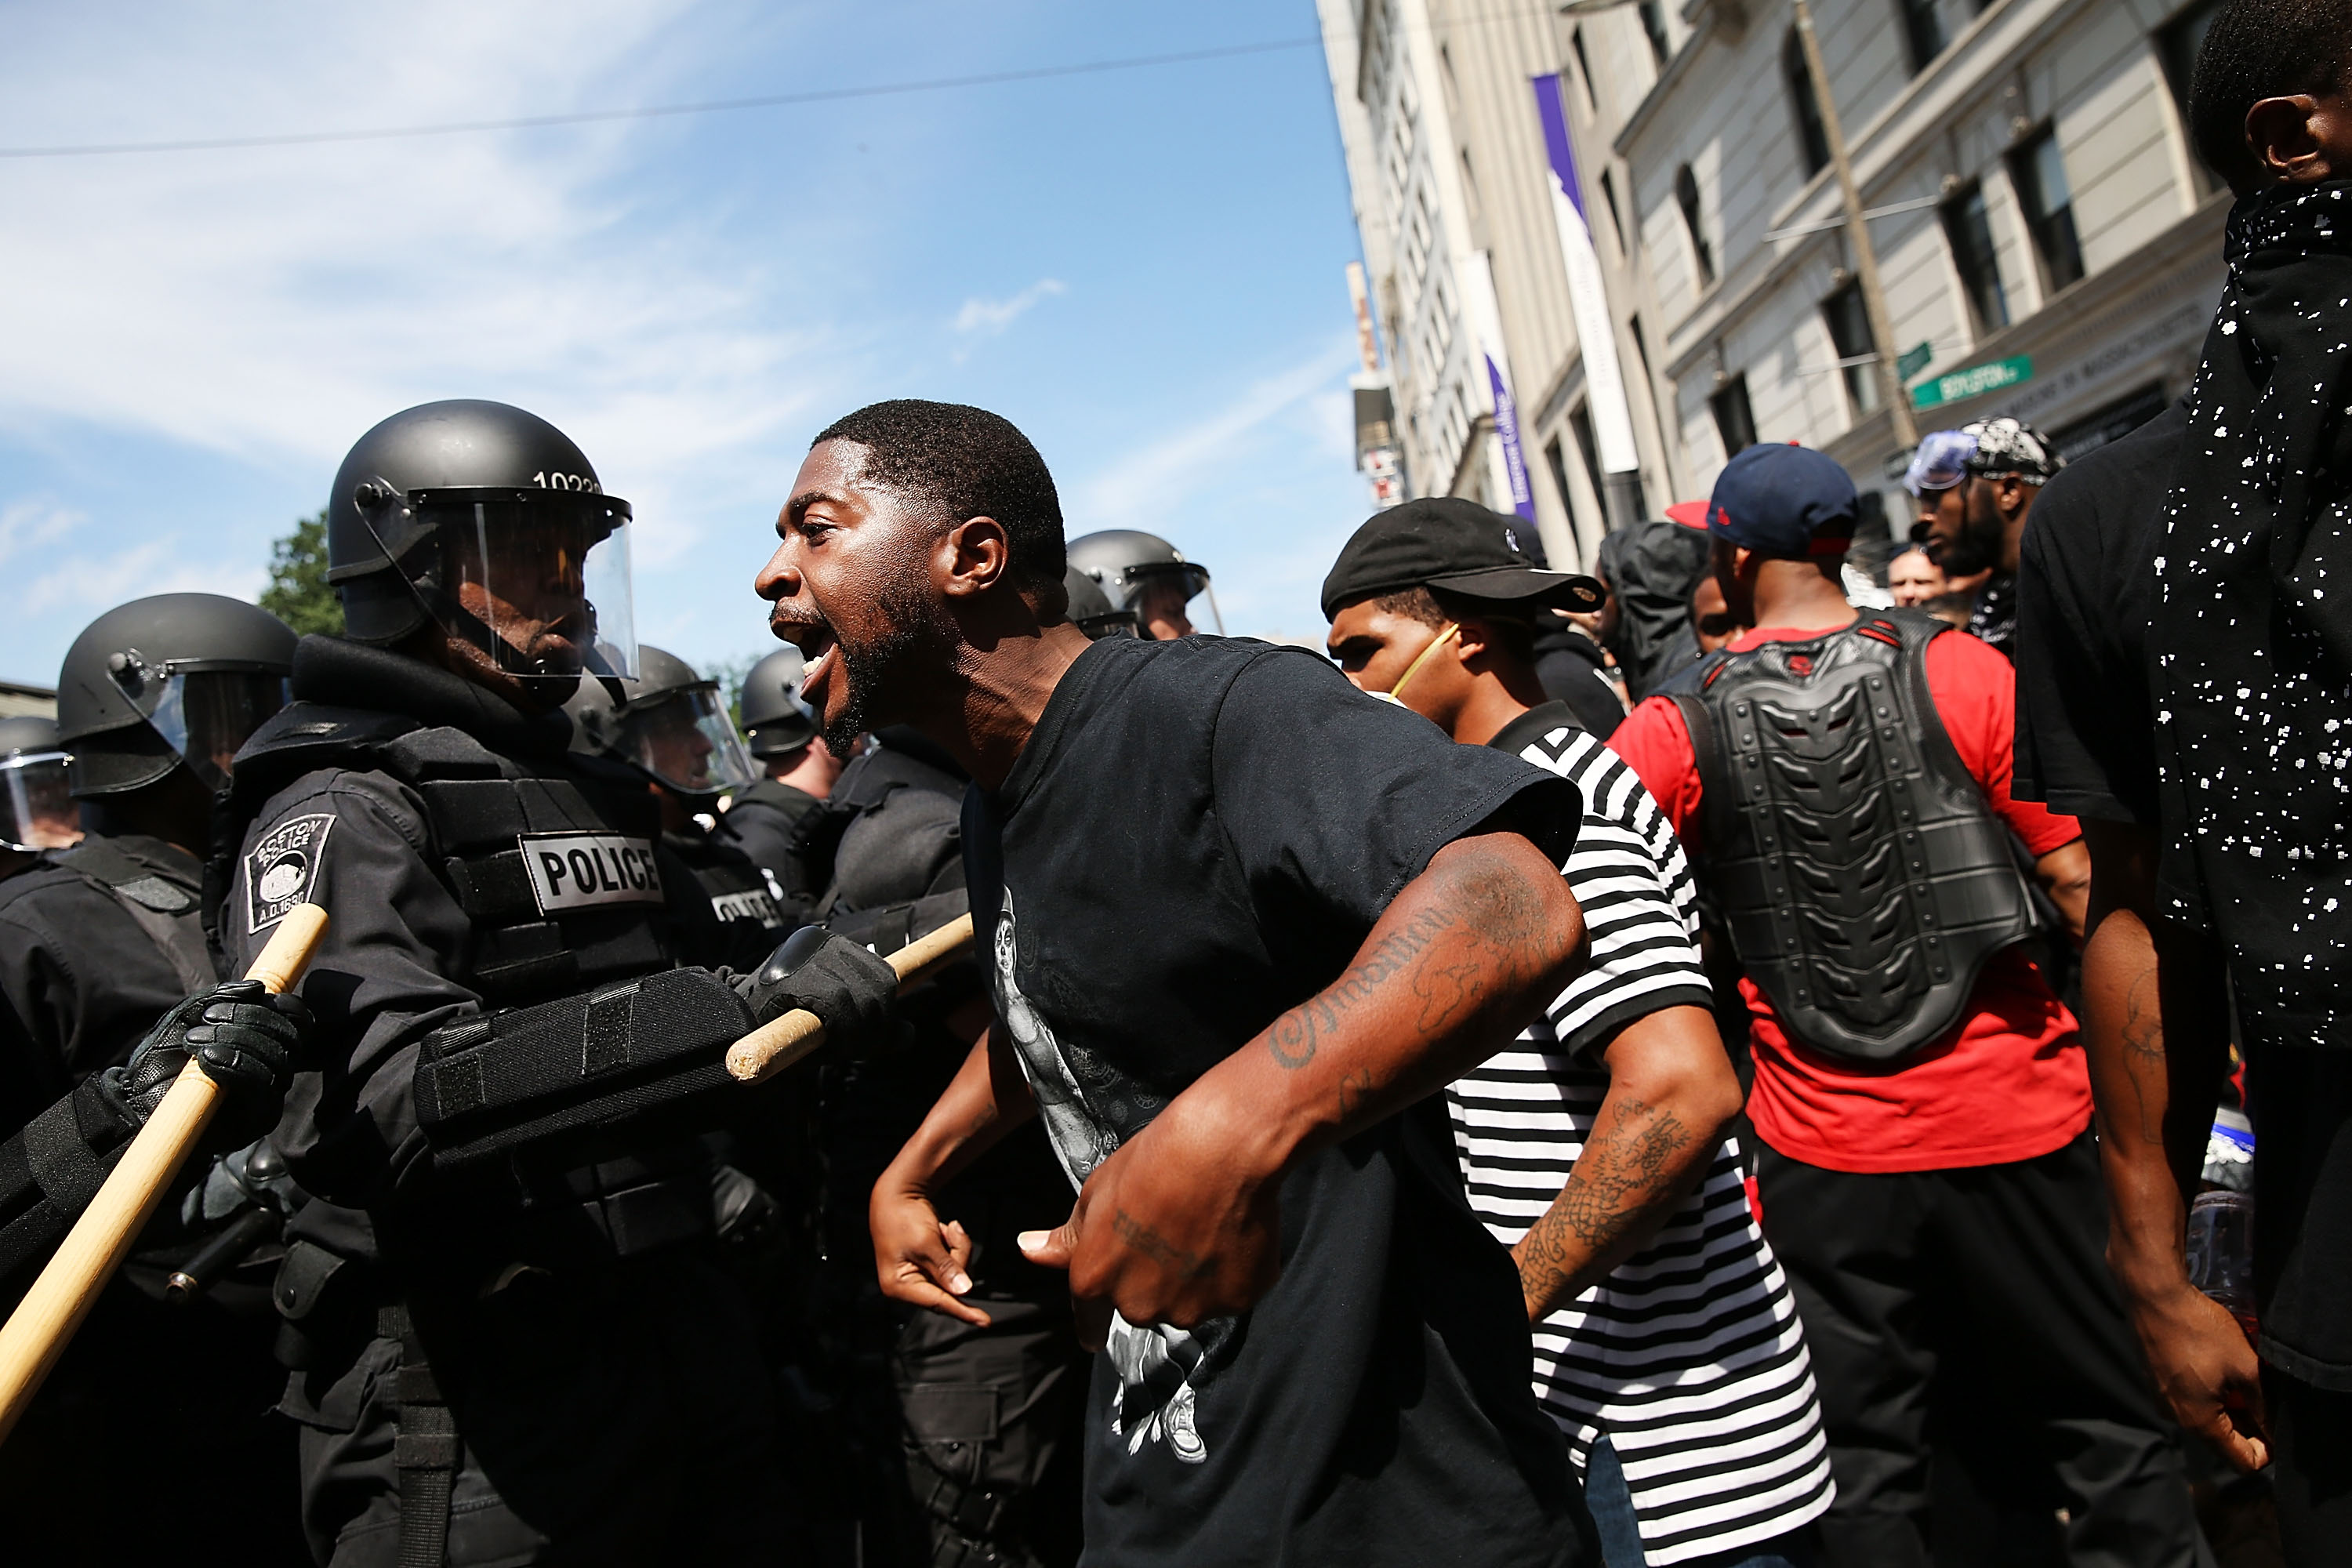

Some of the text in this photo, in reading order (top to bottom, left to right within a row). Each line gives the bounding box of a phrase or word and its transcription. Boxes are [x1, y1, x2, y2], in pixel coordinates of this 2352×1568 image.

[257, 820, 321, 863] BOSTON
[263, 833, 310, 867] POLICE
[539, 846, 659, 896] POLICE
